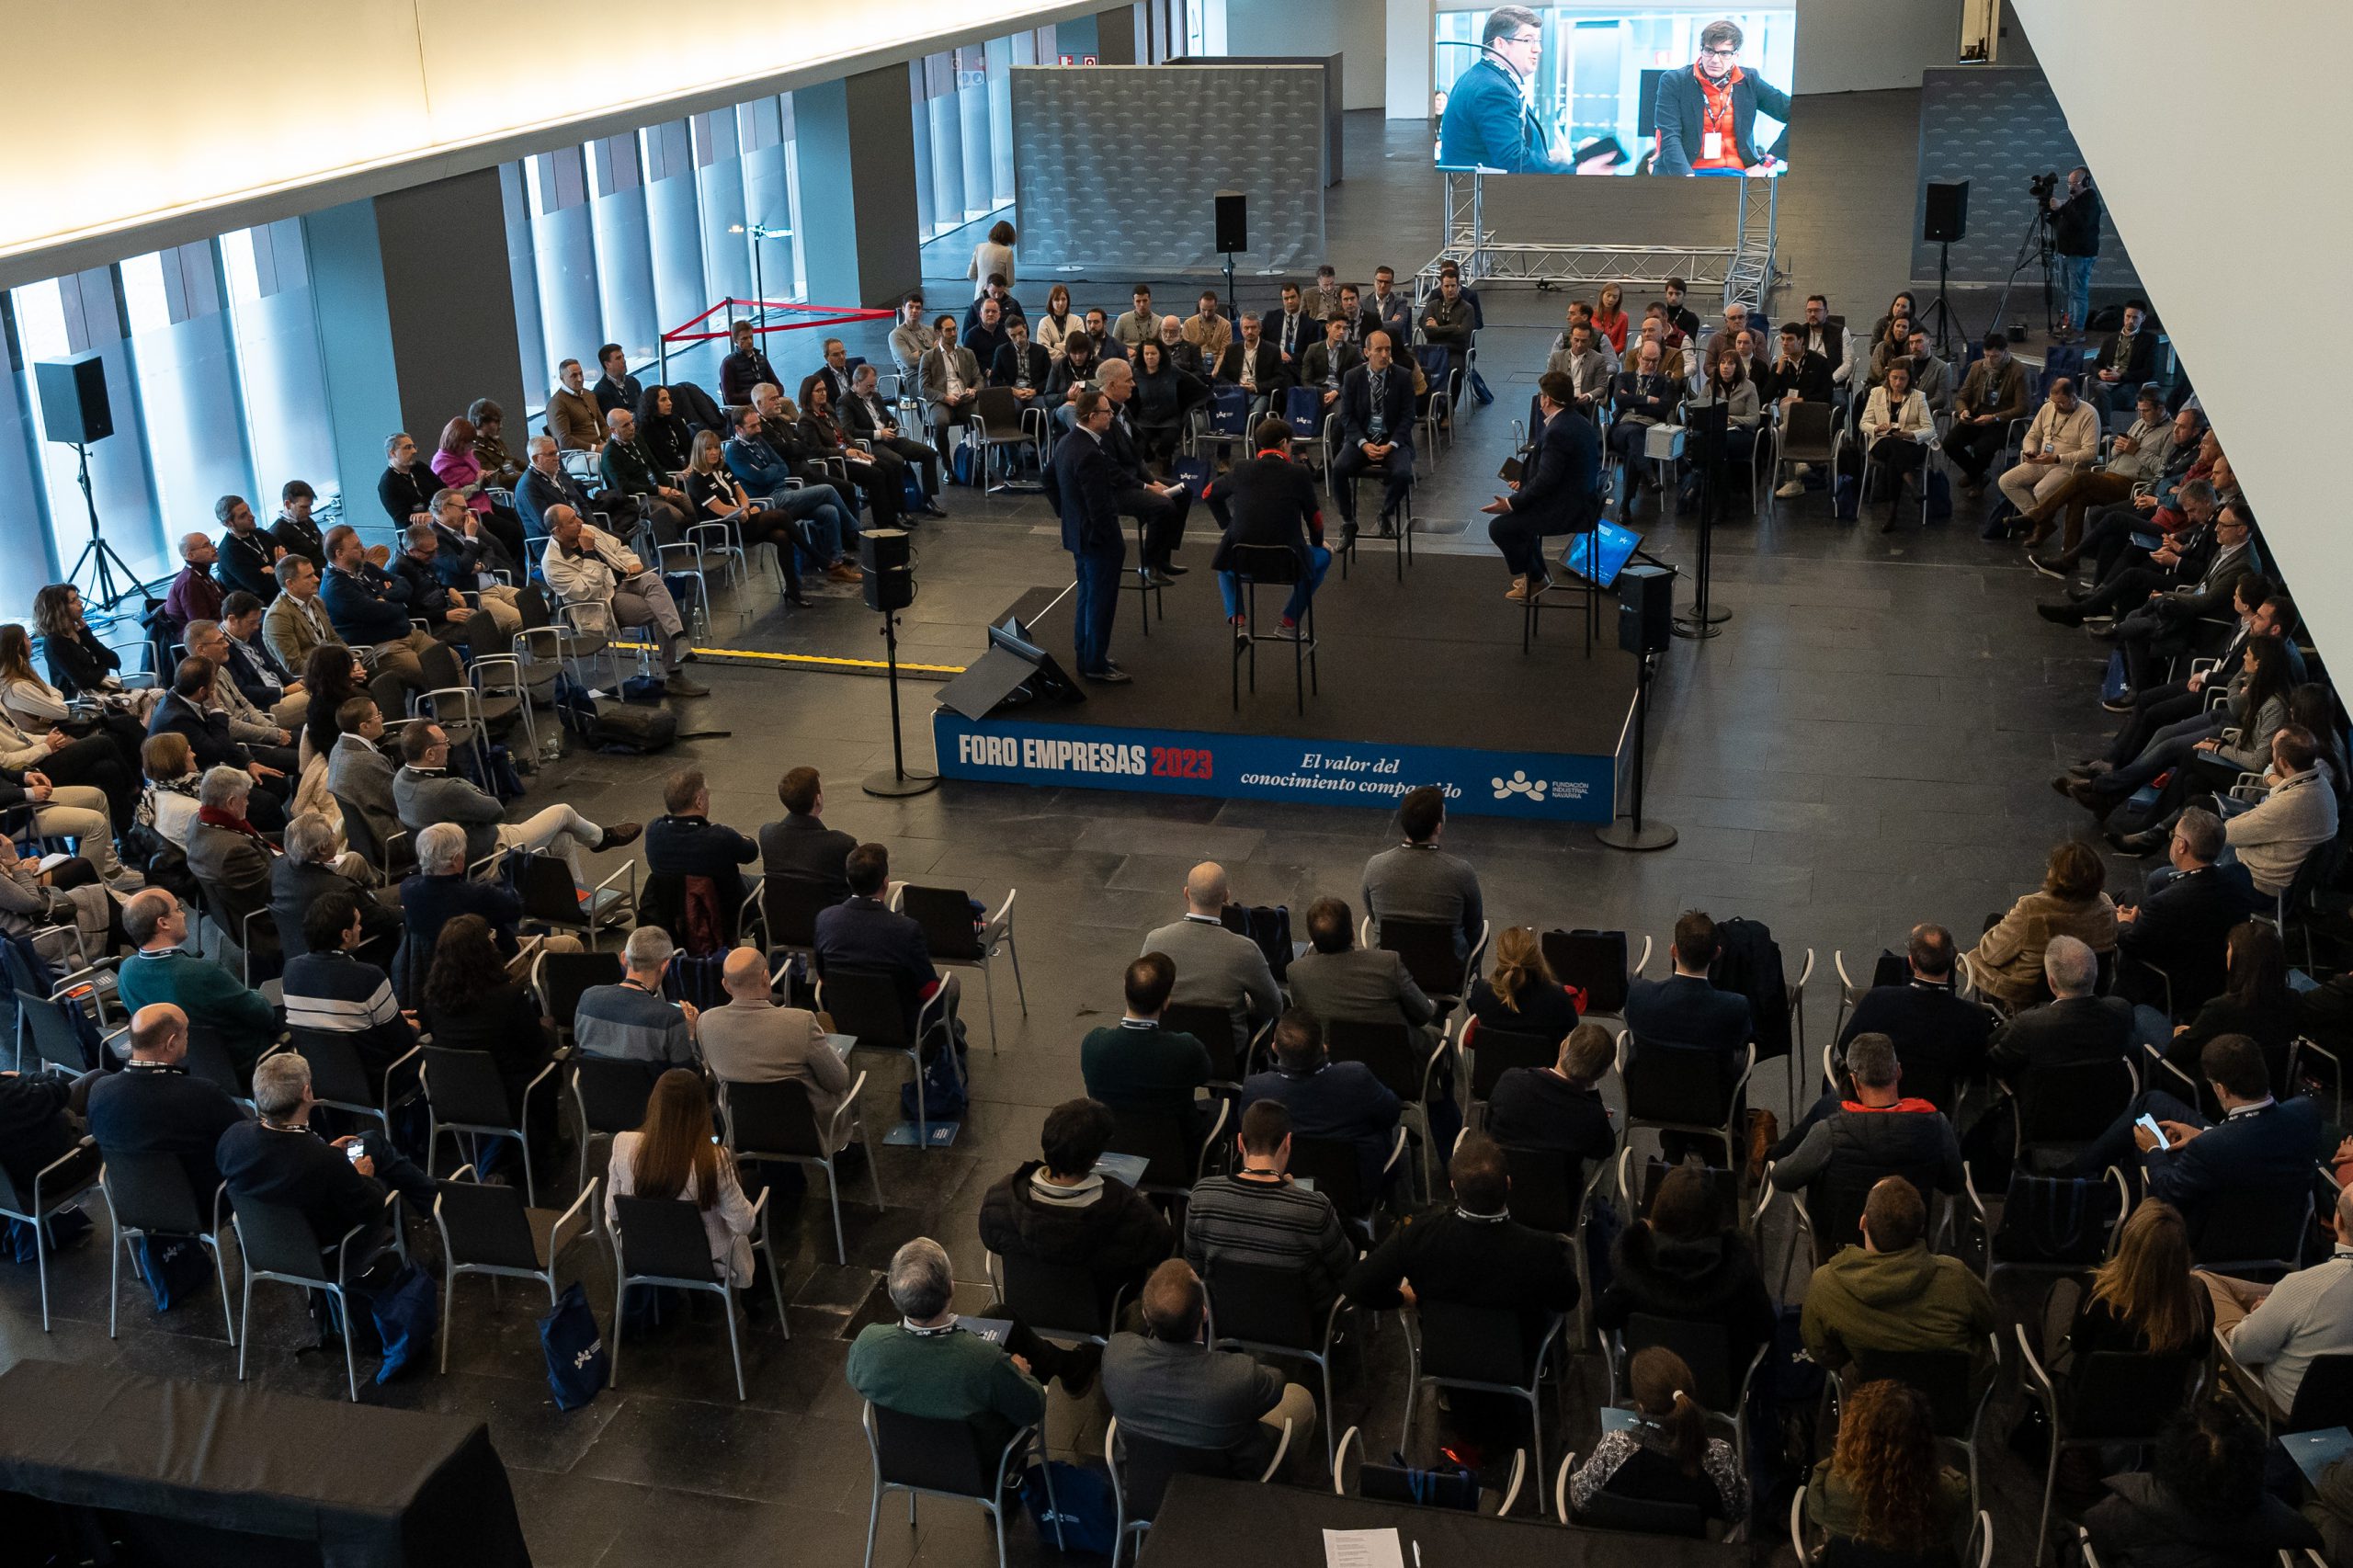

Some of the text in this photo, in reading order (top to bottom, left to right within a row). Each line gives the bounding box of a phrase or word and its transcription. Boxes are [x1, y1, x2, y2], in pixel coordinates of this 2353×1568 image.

[959, 734, 1213, 779] FORO EMPRESAS 2023
[1301, 753, 1399, 774] El valor del
[1241, 772, 1462, 799] conocimiento compado
